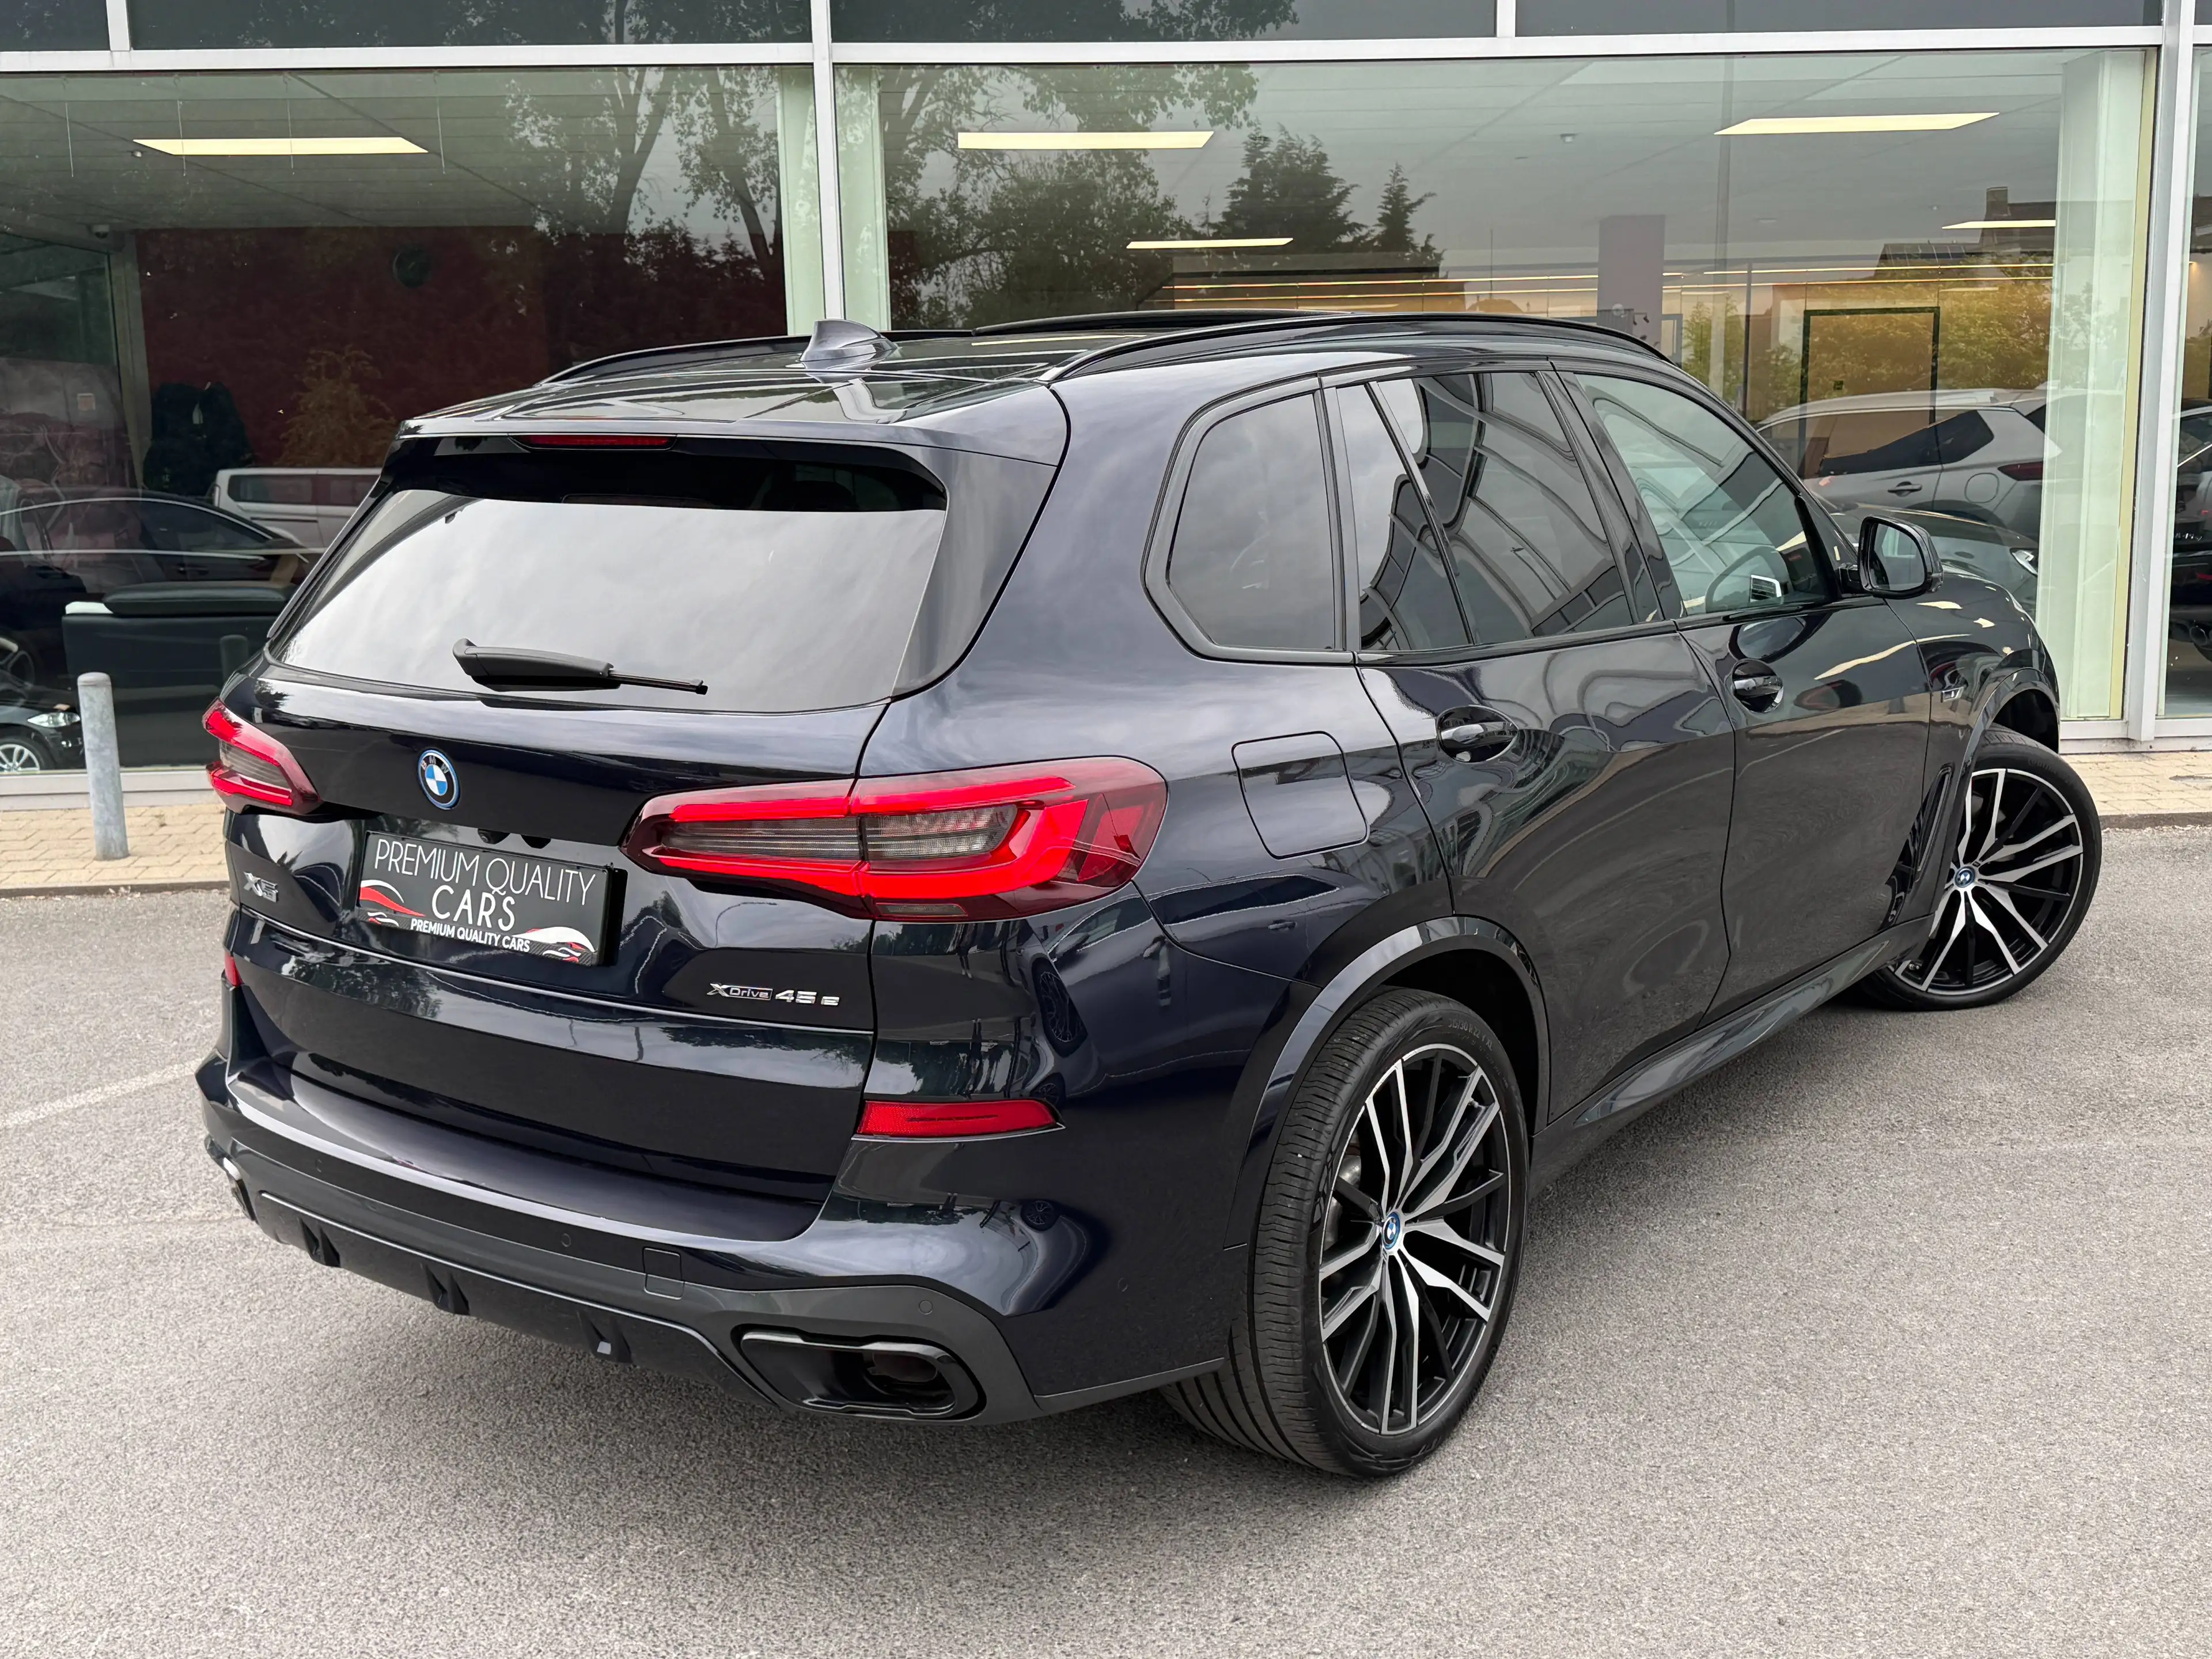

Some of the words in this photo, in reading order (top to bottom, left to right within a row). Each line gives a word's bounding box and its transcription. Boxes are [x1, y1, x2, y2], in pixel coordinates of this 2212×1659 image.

[243, 870, 278, 903] X5
[375, 839, 480, 887] PREMIUM
[486, 858, 596, 906] QUALITY
[431, 885, 516, 931] CARS
[410, 918, 456, 938] PREMIUM
[456, 928, 501, 946] QUALITY
[502, 935, 531, 952] CARS
